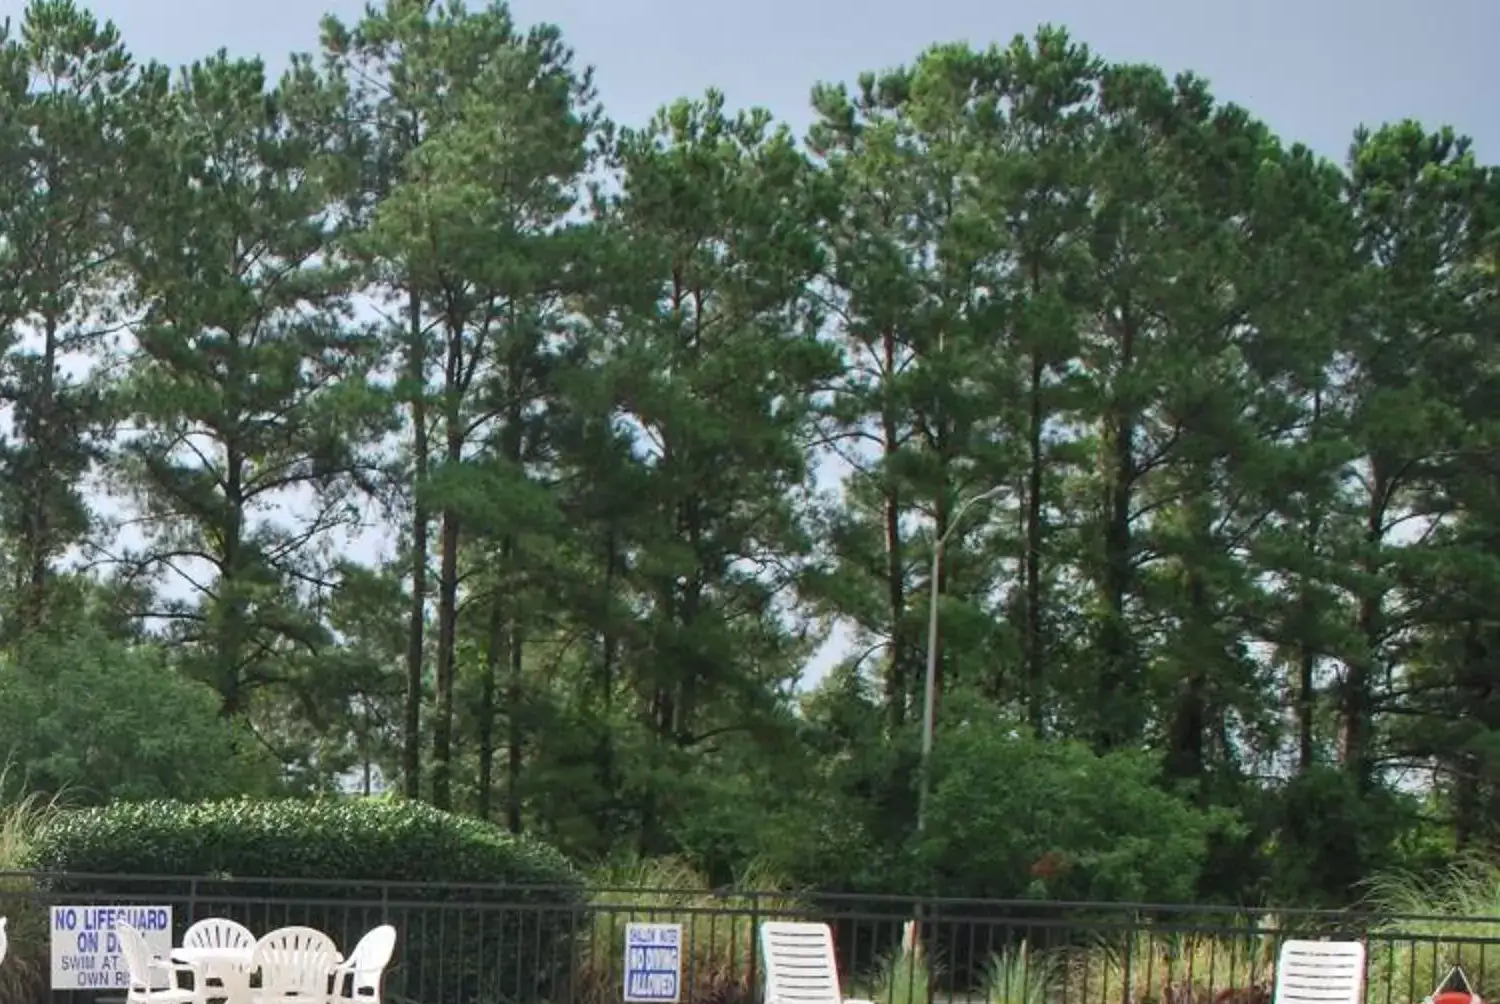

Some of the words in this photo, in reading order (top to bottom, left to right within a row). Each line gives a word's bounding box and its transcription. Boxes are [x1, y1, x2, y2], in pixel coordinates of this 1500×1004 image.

[55, 908, 77, 930] NO
[77, 931, 99, 953] ON
[61, 955, 96, 971] SWIM
[102, 955, 119, 971] AT
[630, 948, 645, 970] NO
[77, 971, 109, 986] OWN
